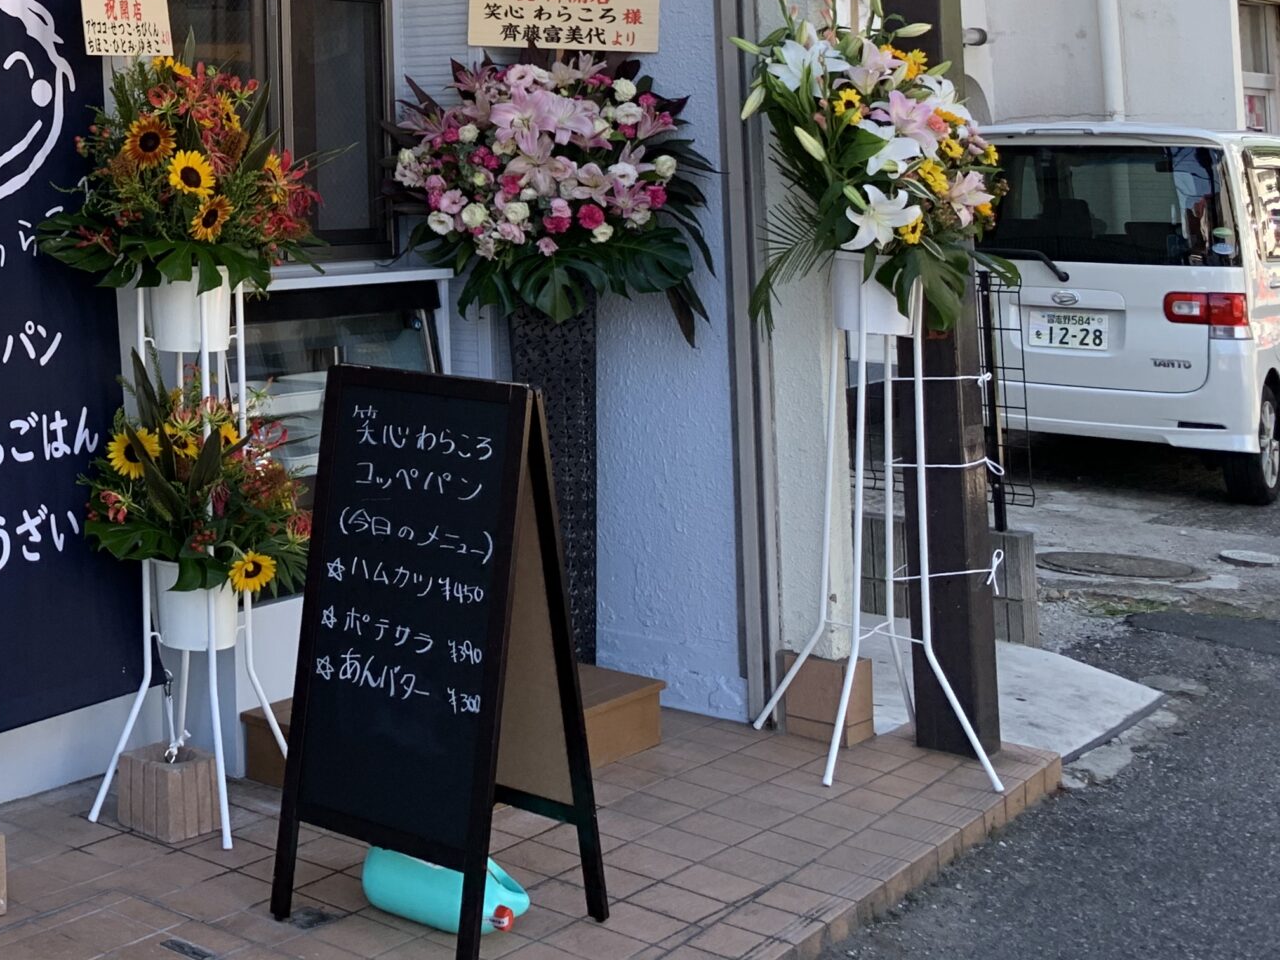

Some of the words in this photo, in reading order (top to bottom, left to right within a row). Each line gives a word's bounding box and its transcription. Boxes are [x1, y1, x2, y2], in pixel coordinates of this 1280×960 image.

[484, 2, 525, 21] 笑心
[534, 5, 617, 24] わらころ
[622, 8, 644, 25] 様
[611, 30, 636, 47] より
[1048, 326, 1103, 347] 12-28
[355, 461, 482, 500] コッペパン
[351, 556, 433, 597] ハムカツ
[343, 607, 434, 653] ポテサラ
[338, 648, 430, 700] あんバター
